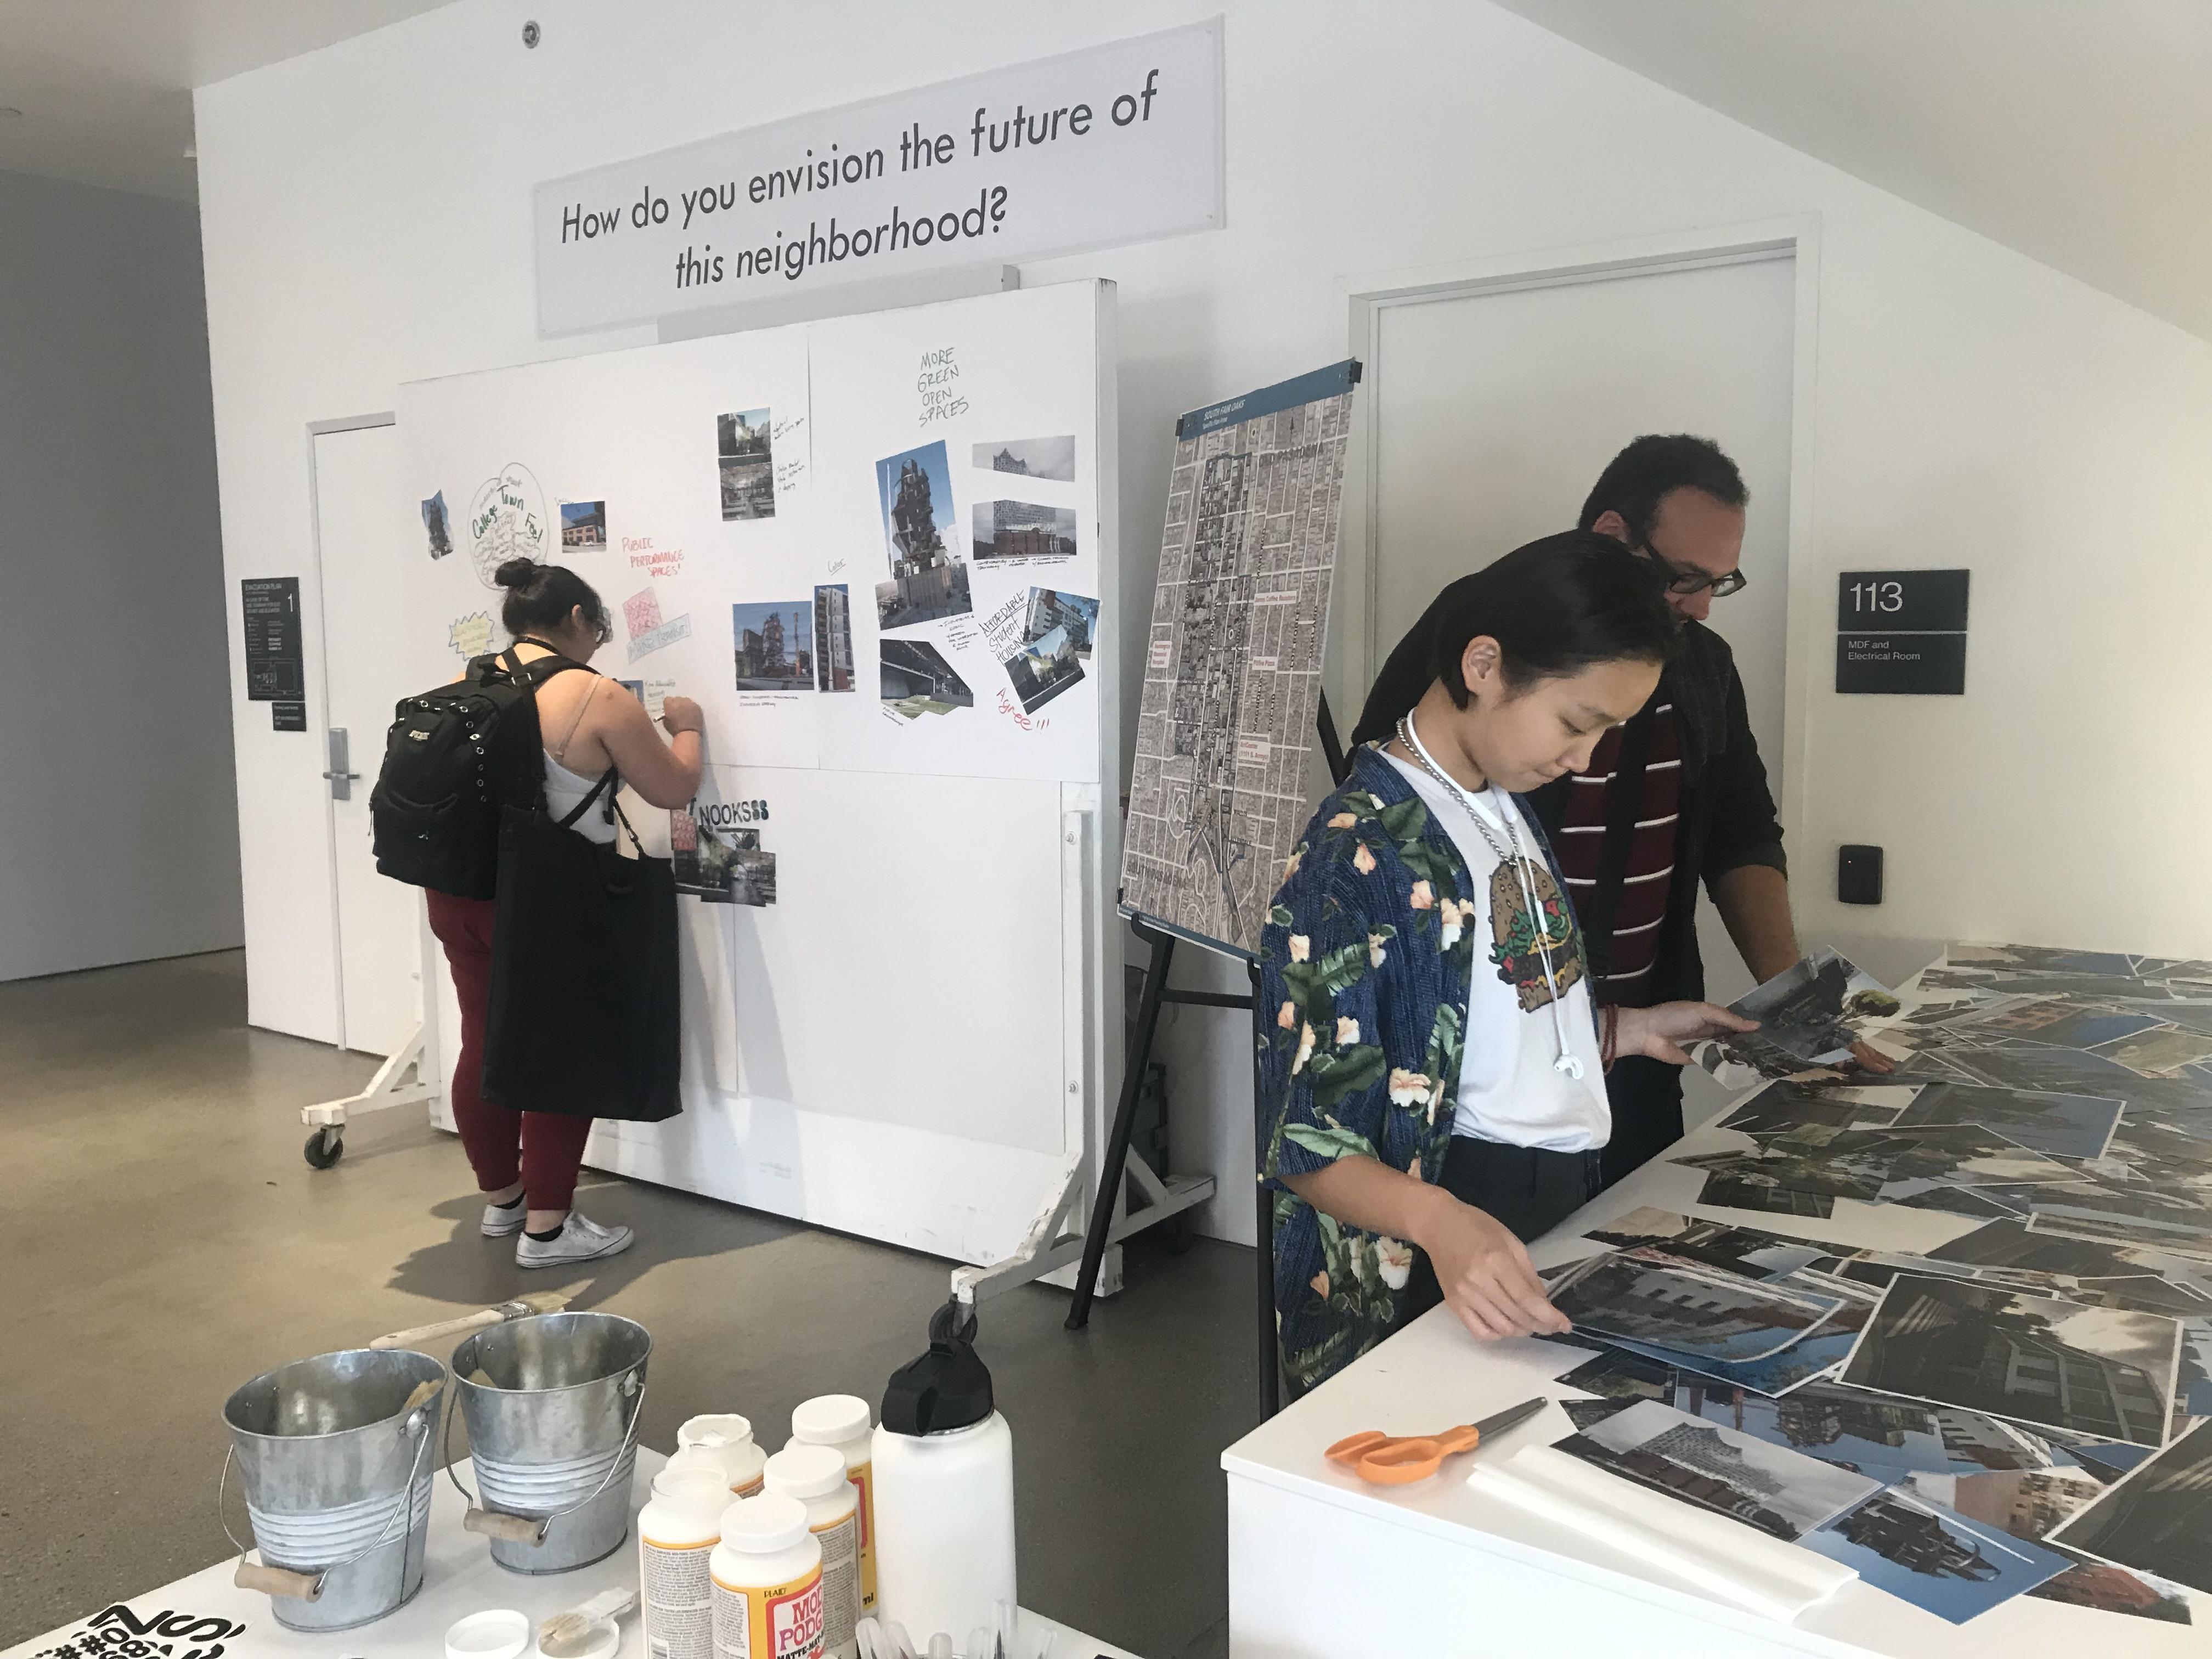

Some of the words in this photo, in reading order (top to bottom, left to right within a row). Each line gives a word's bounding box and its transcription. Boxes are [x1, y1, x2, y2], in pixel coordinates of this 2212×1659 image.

[562, 203, 620, 244] How
[632, 185, 669, 229] do
[681, 182, 735, 230] you
[749, 144, 884, 203] envision
[900, 122, 955, 172] the
[970, 104, 1092, 157] future
[1111, 69, 1159, 126] of
[676, 245, 724, 288] this
[732, 180, 1007, 280] neighborhood?
[921, 347, 955, 370] MORE
[917, 364, 960, 393] GREEN
[922, 386, 952, 406] OPEN
[918, 396, 969, 427] SPACES
[496, 484, 524, 511] Town
[622, 537, 654, 552] PUBLIC
[630, 549, 685, 568] PERFORMANCE
[287, 593, 294, 613] 1
[1849, 582, 1903, 612] 113
[979, 590, 1025, 636] AFFORDABLE
[1848, 641, 1870, 649] MDF
[1871, 641, 1889, 649] and
[1848, 652, 1891, 661] Electrical
[1893, 652, 1921, 661] Room
[764, 1587, 787, 1598] PLAID
[779, 1609, 822, 1651] PODG
